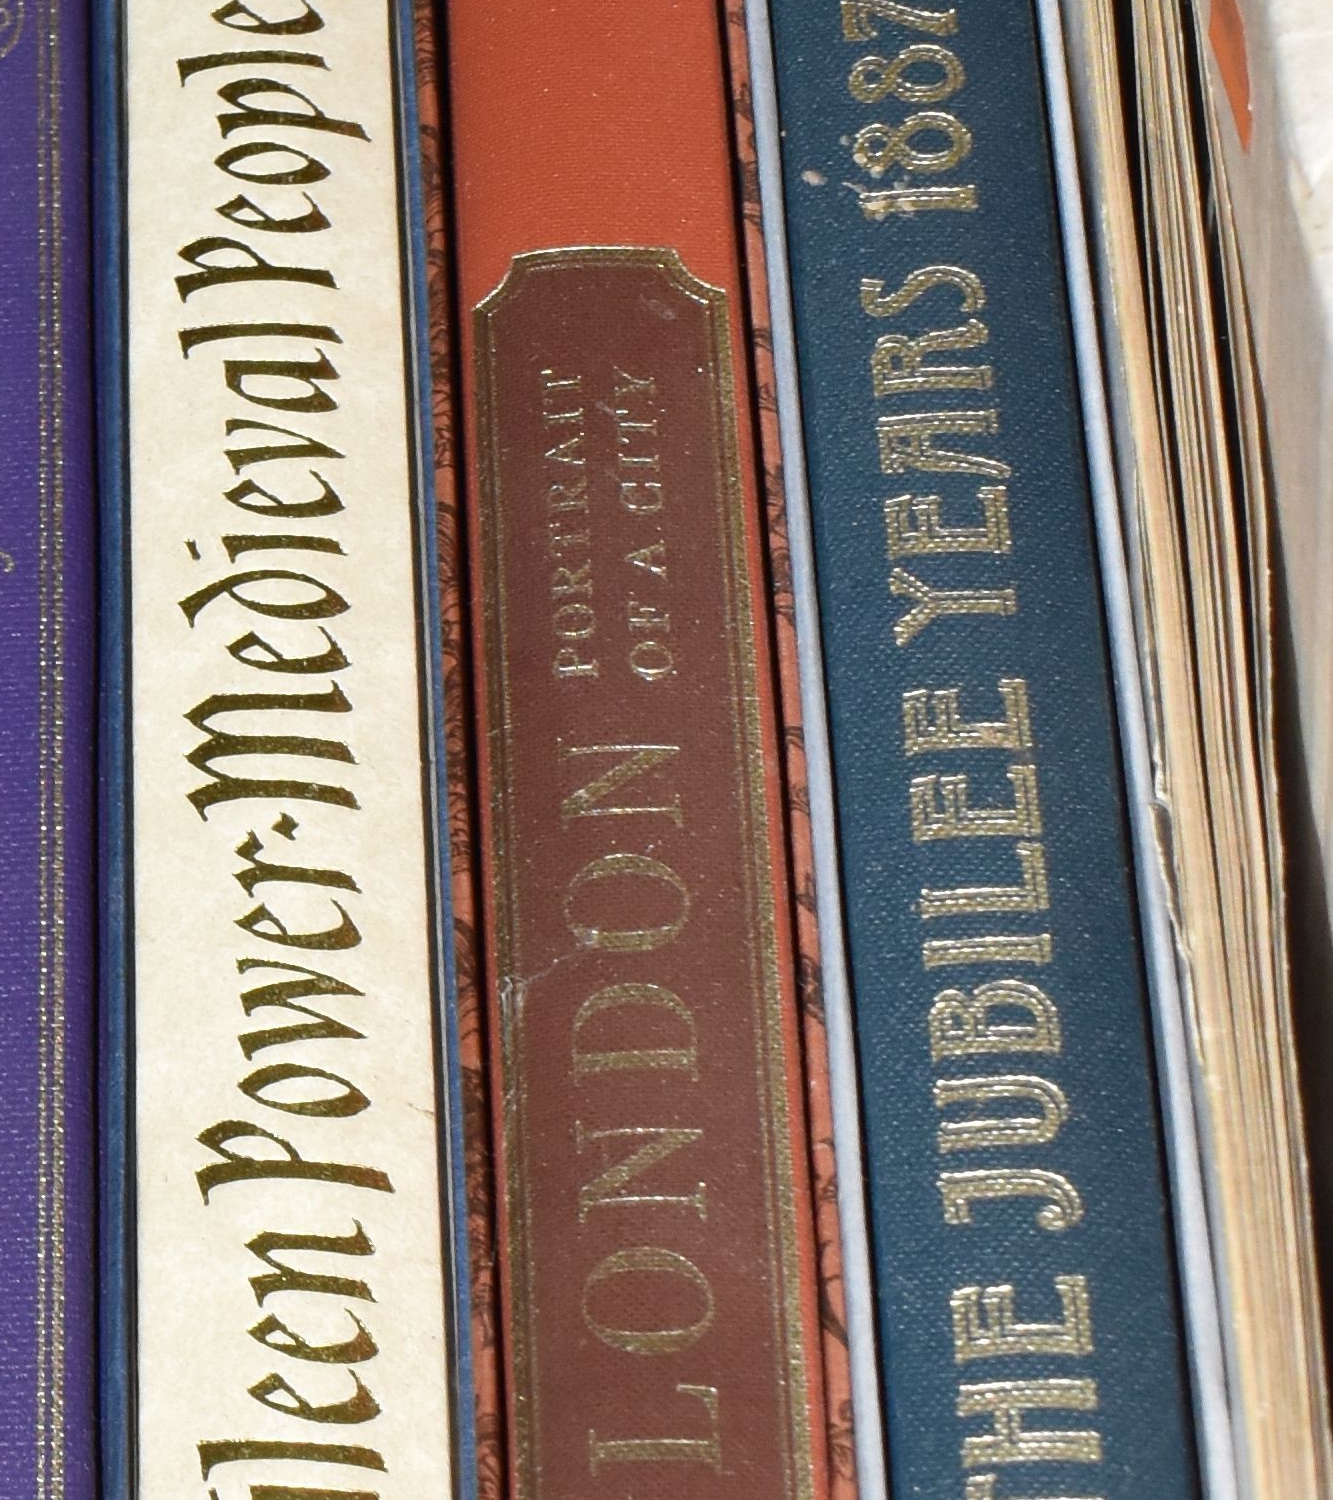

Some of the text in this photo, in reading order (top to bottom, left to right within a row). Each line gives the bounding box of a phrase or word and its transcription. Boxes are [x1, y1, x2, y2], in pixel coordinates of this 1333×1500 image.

[540, 368, 600, 681] PORTRAIT
[613, 365, 678, 682] OF A CITY
[858, 263, 1021, 648] YEARS
[556, 736, 736, 1479] LONDON
[902, 676, 1084, 1234] JUBILEE
